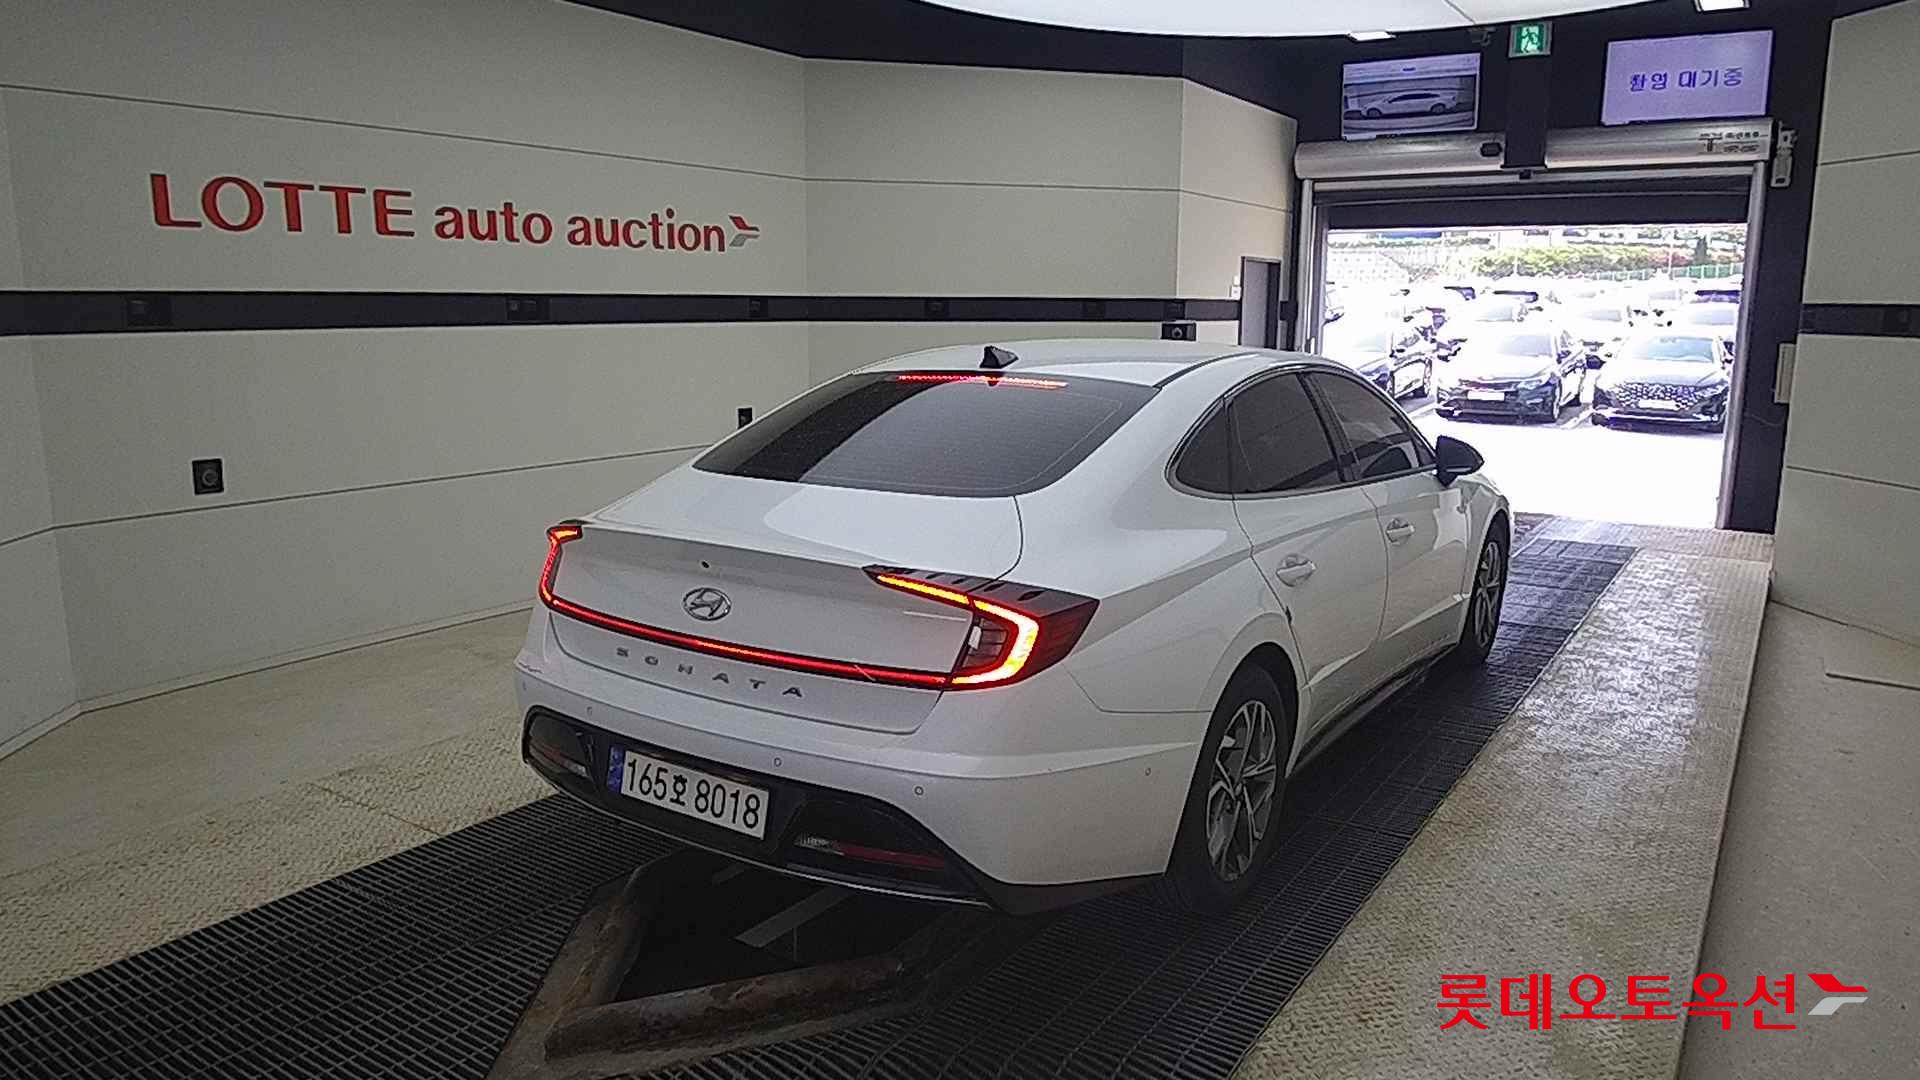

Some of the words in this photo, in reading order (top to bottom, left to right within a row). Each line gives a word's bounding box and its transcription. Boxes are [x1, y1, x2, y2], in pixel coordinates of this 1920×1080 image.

[150, 173, 415, 238] LOTTE
[433, 202, 553, 245] auto
[567, 207, 726, 253] auction
[616, 647, 802, 697] SONATA
